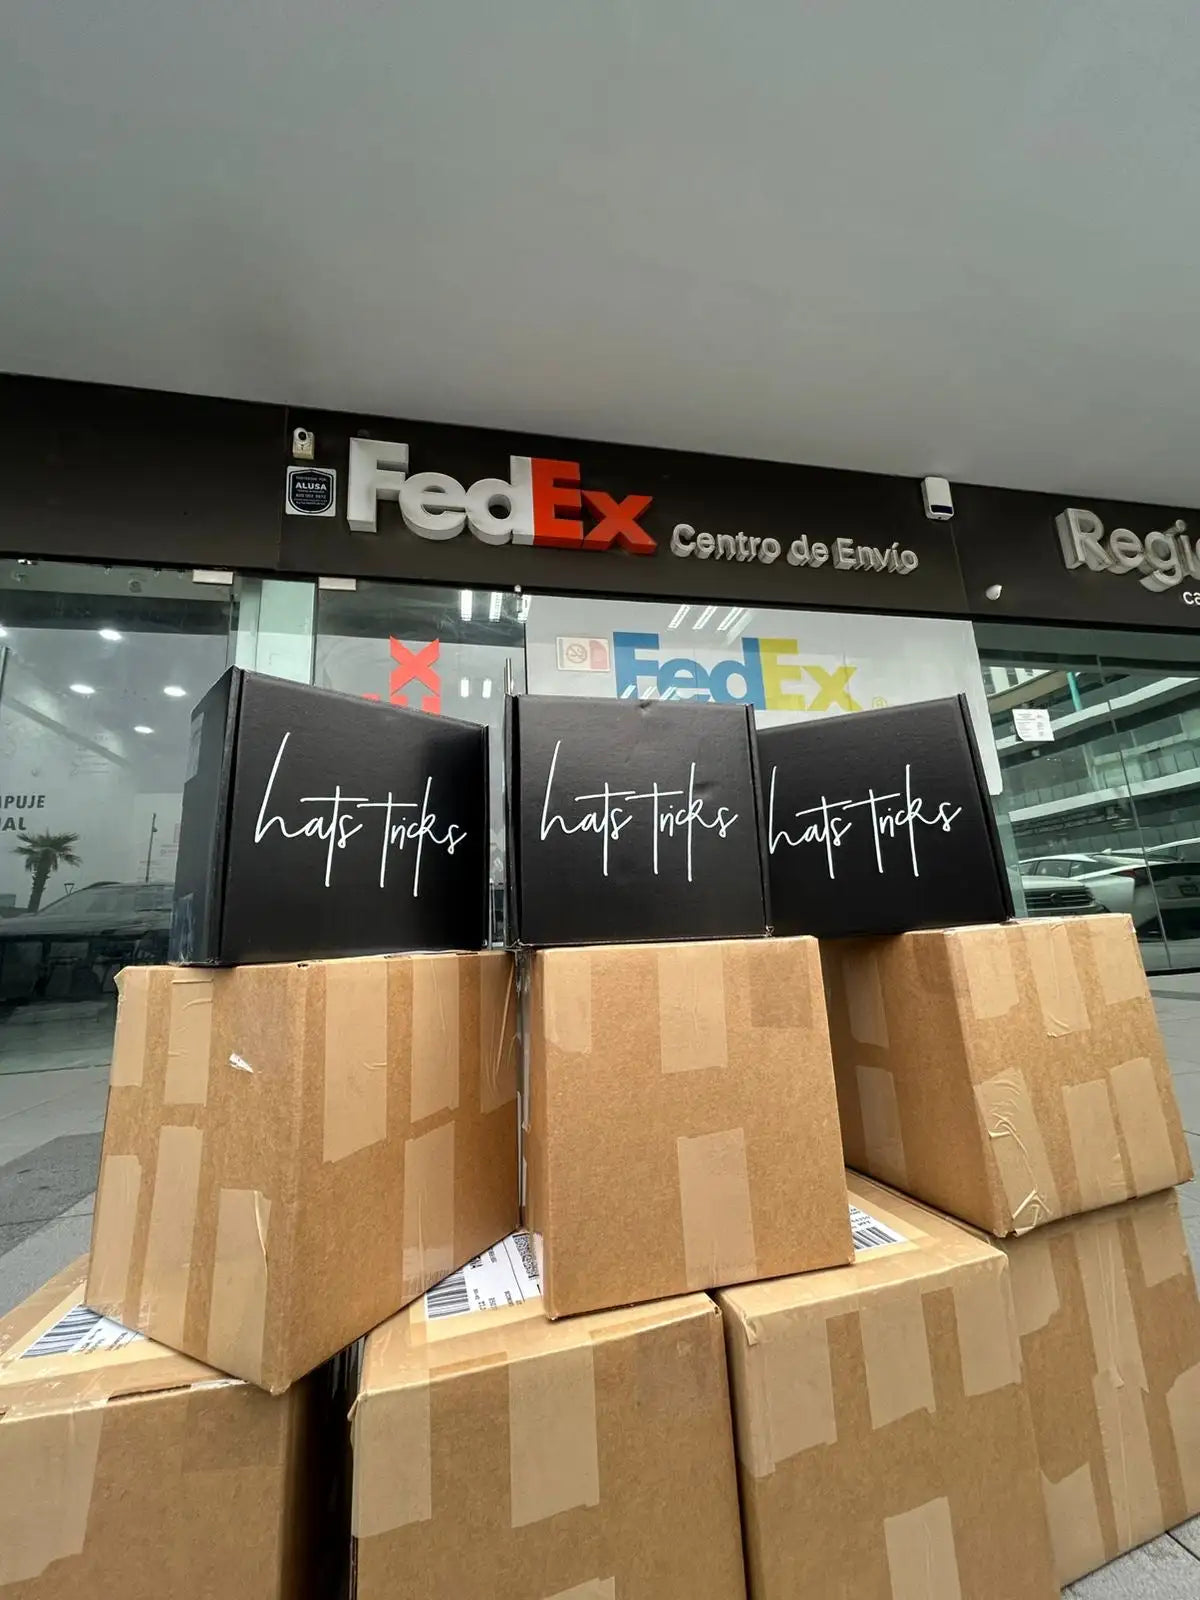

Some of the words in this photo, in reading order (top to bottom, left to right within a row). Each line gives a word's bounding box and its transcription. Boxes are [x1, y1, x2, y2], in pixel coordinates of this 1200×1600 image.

[295, 482, 327, 490] ALUSA
[347, 437, 657, 554] FedEx
[670, 523, 782, 565] Centro
[786, 533, 829, 567] de
[832, 537, 920, 576] Envío
[613, 631, 862, 712] FedEx
[0, 795, 46, 809] PUJE
[0, 817, 27, 831] AL
